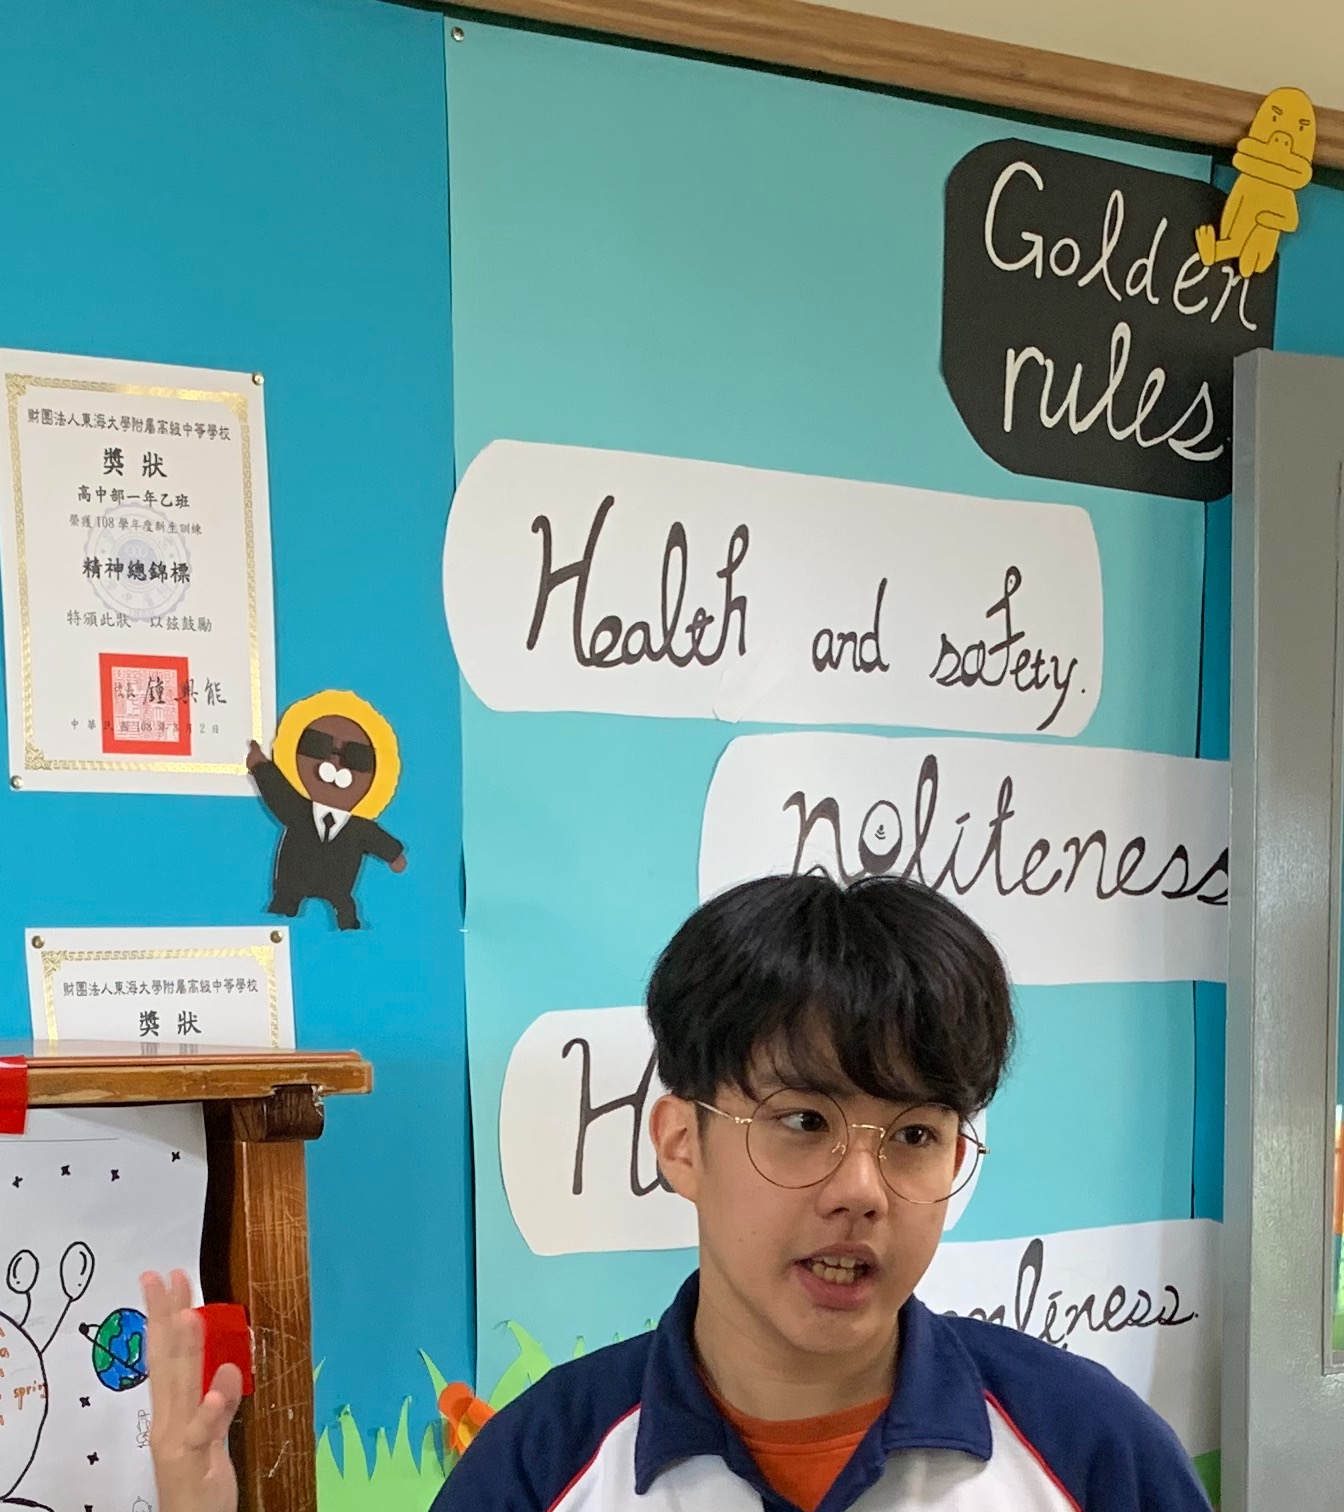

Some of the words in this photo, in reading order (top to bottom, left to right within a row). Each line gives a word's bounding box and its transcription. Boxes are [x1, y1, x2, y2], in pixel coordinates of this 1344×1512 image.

[984, 161, 1257, 331] Golden
[1003, 322, 1224, 461] rules
[27, 408, 232, 441] 財團法人東海大學附屬高級中等學校
[103, 447, 168, 478] 獎狀
[78, 484, 191, 509] 高中部一年乙班
[82, 556, 191, 584] 精神總錦標
[526, 494, 750, 668] Health
[811, 578, 890, 673] and
[63, 978, 259, 997] 財團法人東海大學附屬高級中等學校
[139, 1010, 202, 1037] 獎狀
